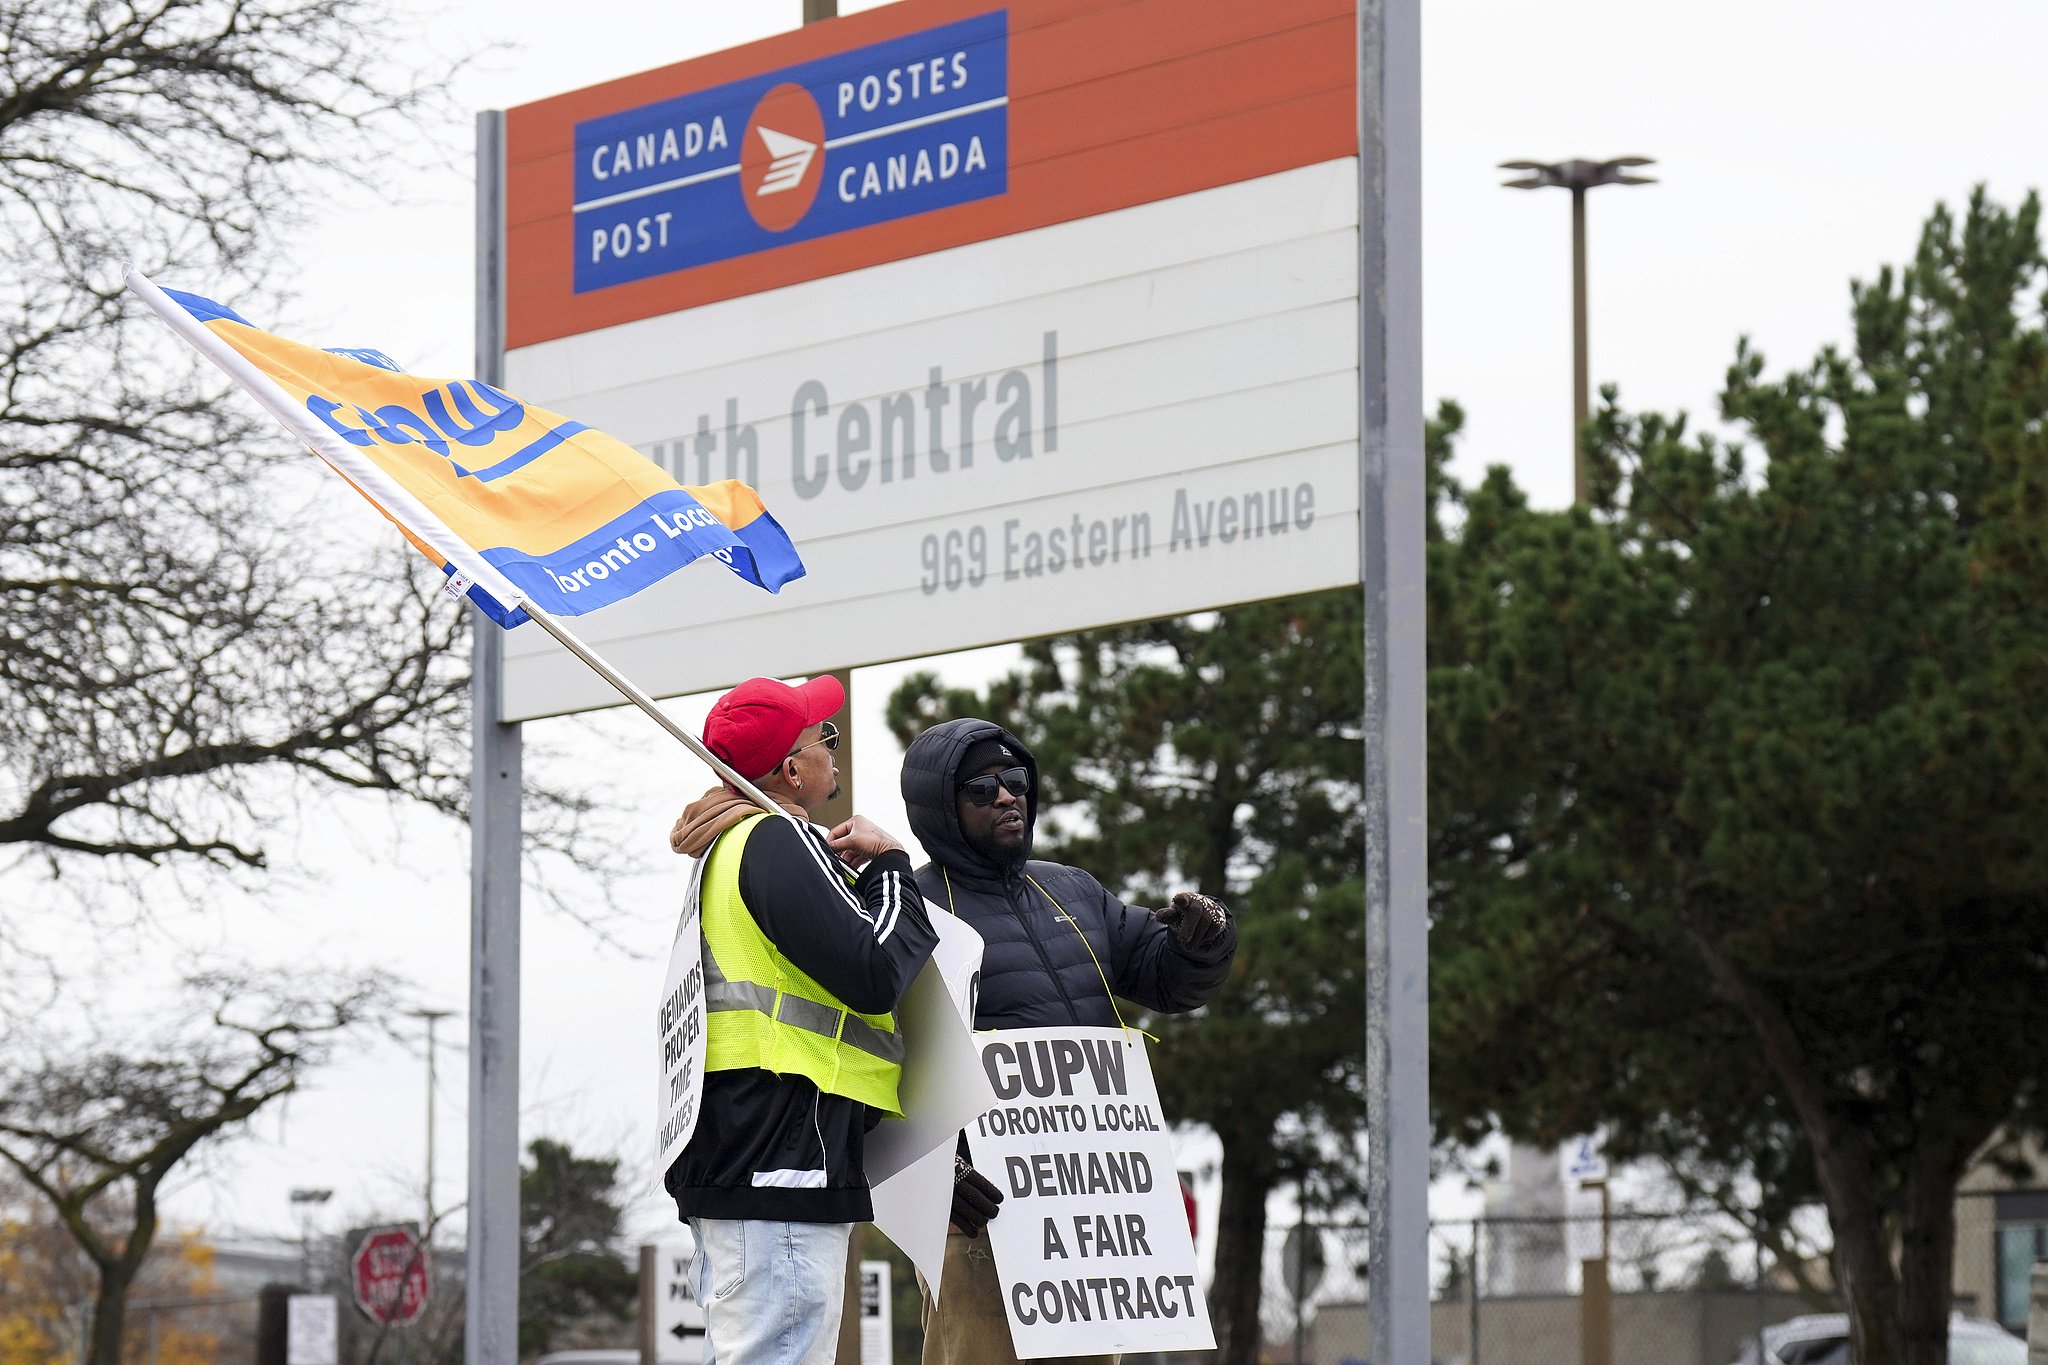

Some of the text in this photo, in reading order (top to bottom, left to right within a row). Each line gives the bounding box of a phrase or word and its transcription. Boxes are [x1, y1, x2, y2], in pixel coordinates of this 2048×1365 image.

[838, 52, 968, 118] POSTES
[592, 116, 728, 181] CANADA
[838, 136, 987, 203] CANADA
[592, 212, 673, 263] POST
[790, 332, 1058, 500] Central
[921, 482, 1314, 597] 969 Eastern Avenue
[661, 960, 701, 1040] DEMANDS
[664, 1005, 700, 1075] PROPER
[982, 1039, 1128, 1101] CUPW
[670, 1056, 693, 1109] TIME
[659, 1093, 694, 1159] VALUES
[977, 1104, 1160, 1137] TORONTO LOCAL
[1005, 1151, 1153, 1200] DEMAND
[1043, 1214, 1153, 1261] A FAIR
[1010, 1275, 1196, 1327] CONTRACT
